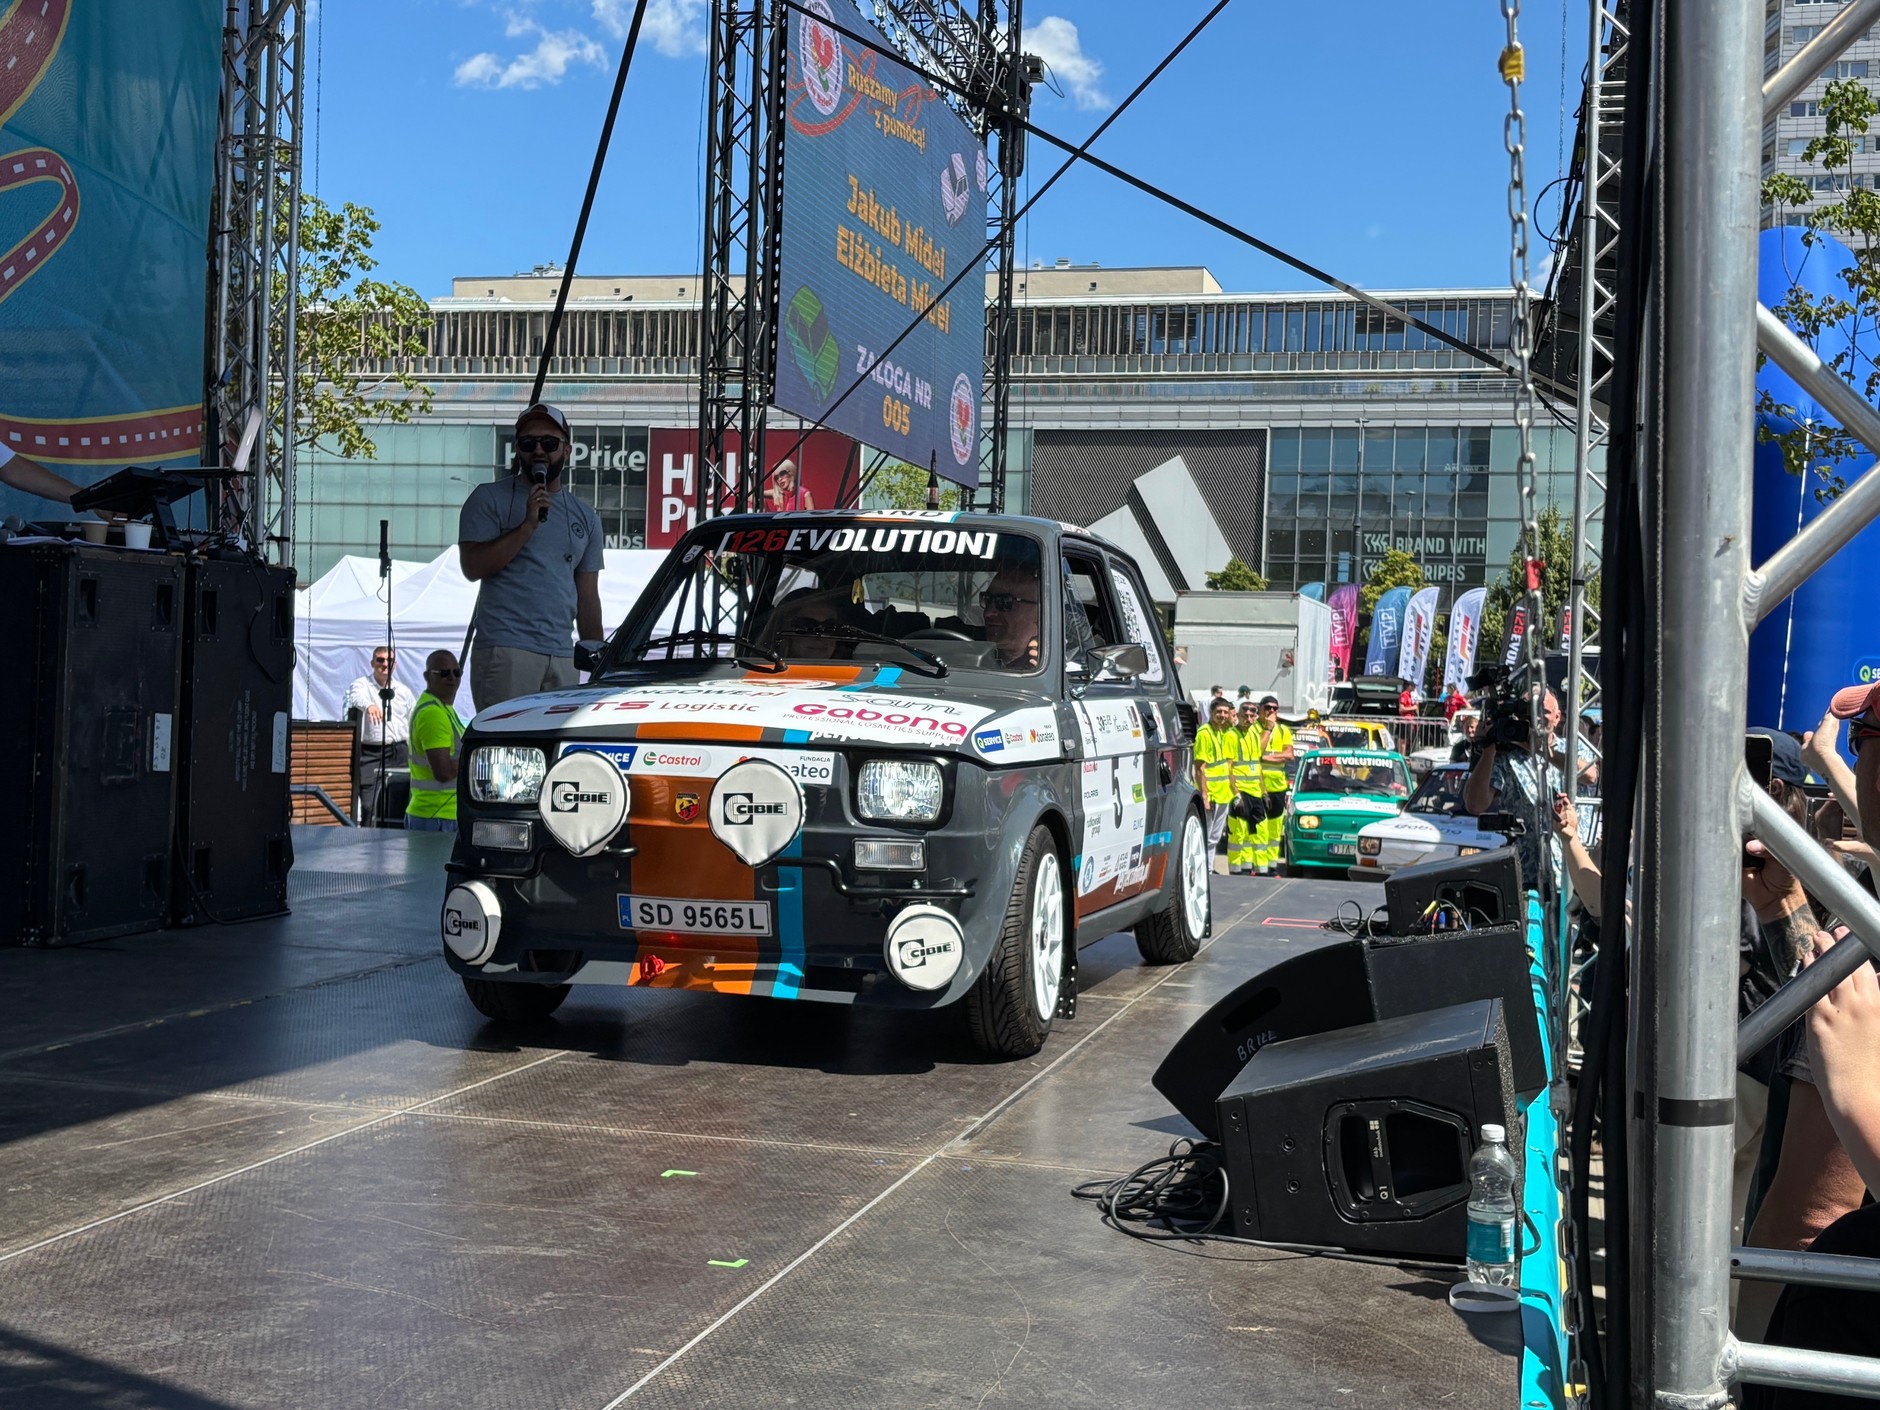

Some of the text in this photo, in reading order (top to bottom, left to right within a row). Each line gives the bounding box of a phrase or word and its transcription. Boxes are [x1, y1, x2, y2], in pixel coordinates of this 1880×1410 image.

[848, 63, 897, 114] Ruszamy
[847, 173, 946, 283] Jakub Midel
[836, 224, 907, 306] Elżbieta
[915, 377, 932, 410] NR
[882, 394, 911, 436] 005
[571, 444, 646, 474] Price
[1396, 536, 1445, 553] BRAND
[1450, 538, 1485, 554] WITH
[1332, 611, 1347, 645] TVP
[1380, 611, 1396, 647] TVP
[544, 700, 760, 715] STS Logistic
[793, 703, 968, 738] Gabona
[783, 713, 855, 726] PROFESSIONAL
[858, 721, 914, 734] COSMETICS
[915, 730, 962, 744] SUPPLIER
[658, 754, 701, 767] Castrol
[799, 755, 831, 763] FUNDACJA
[1112, 757, 1123, 829] 5
[639, 902, 765, 930] SD 9565L
